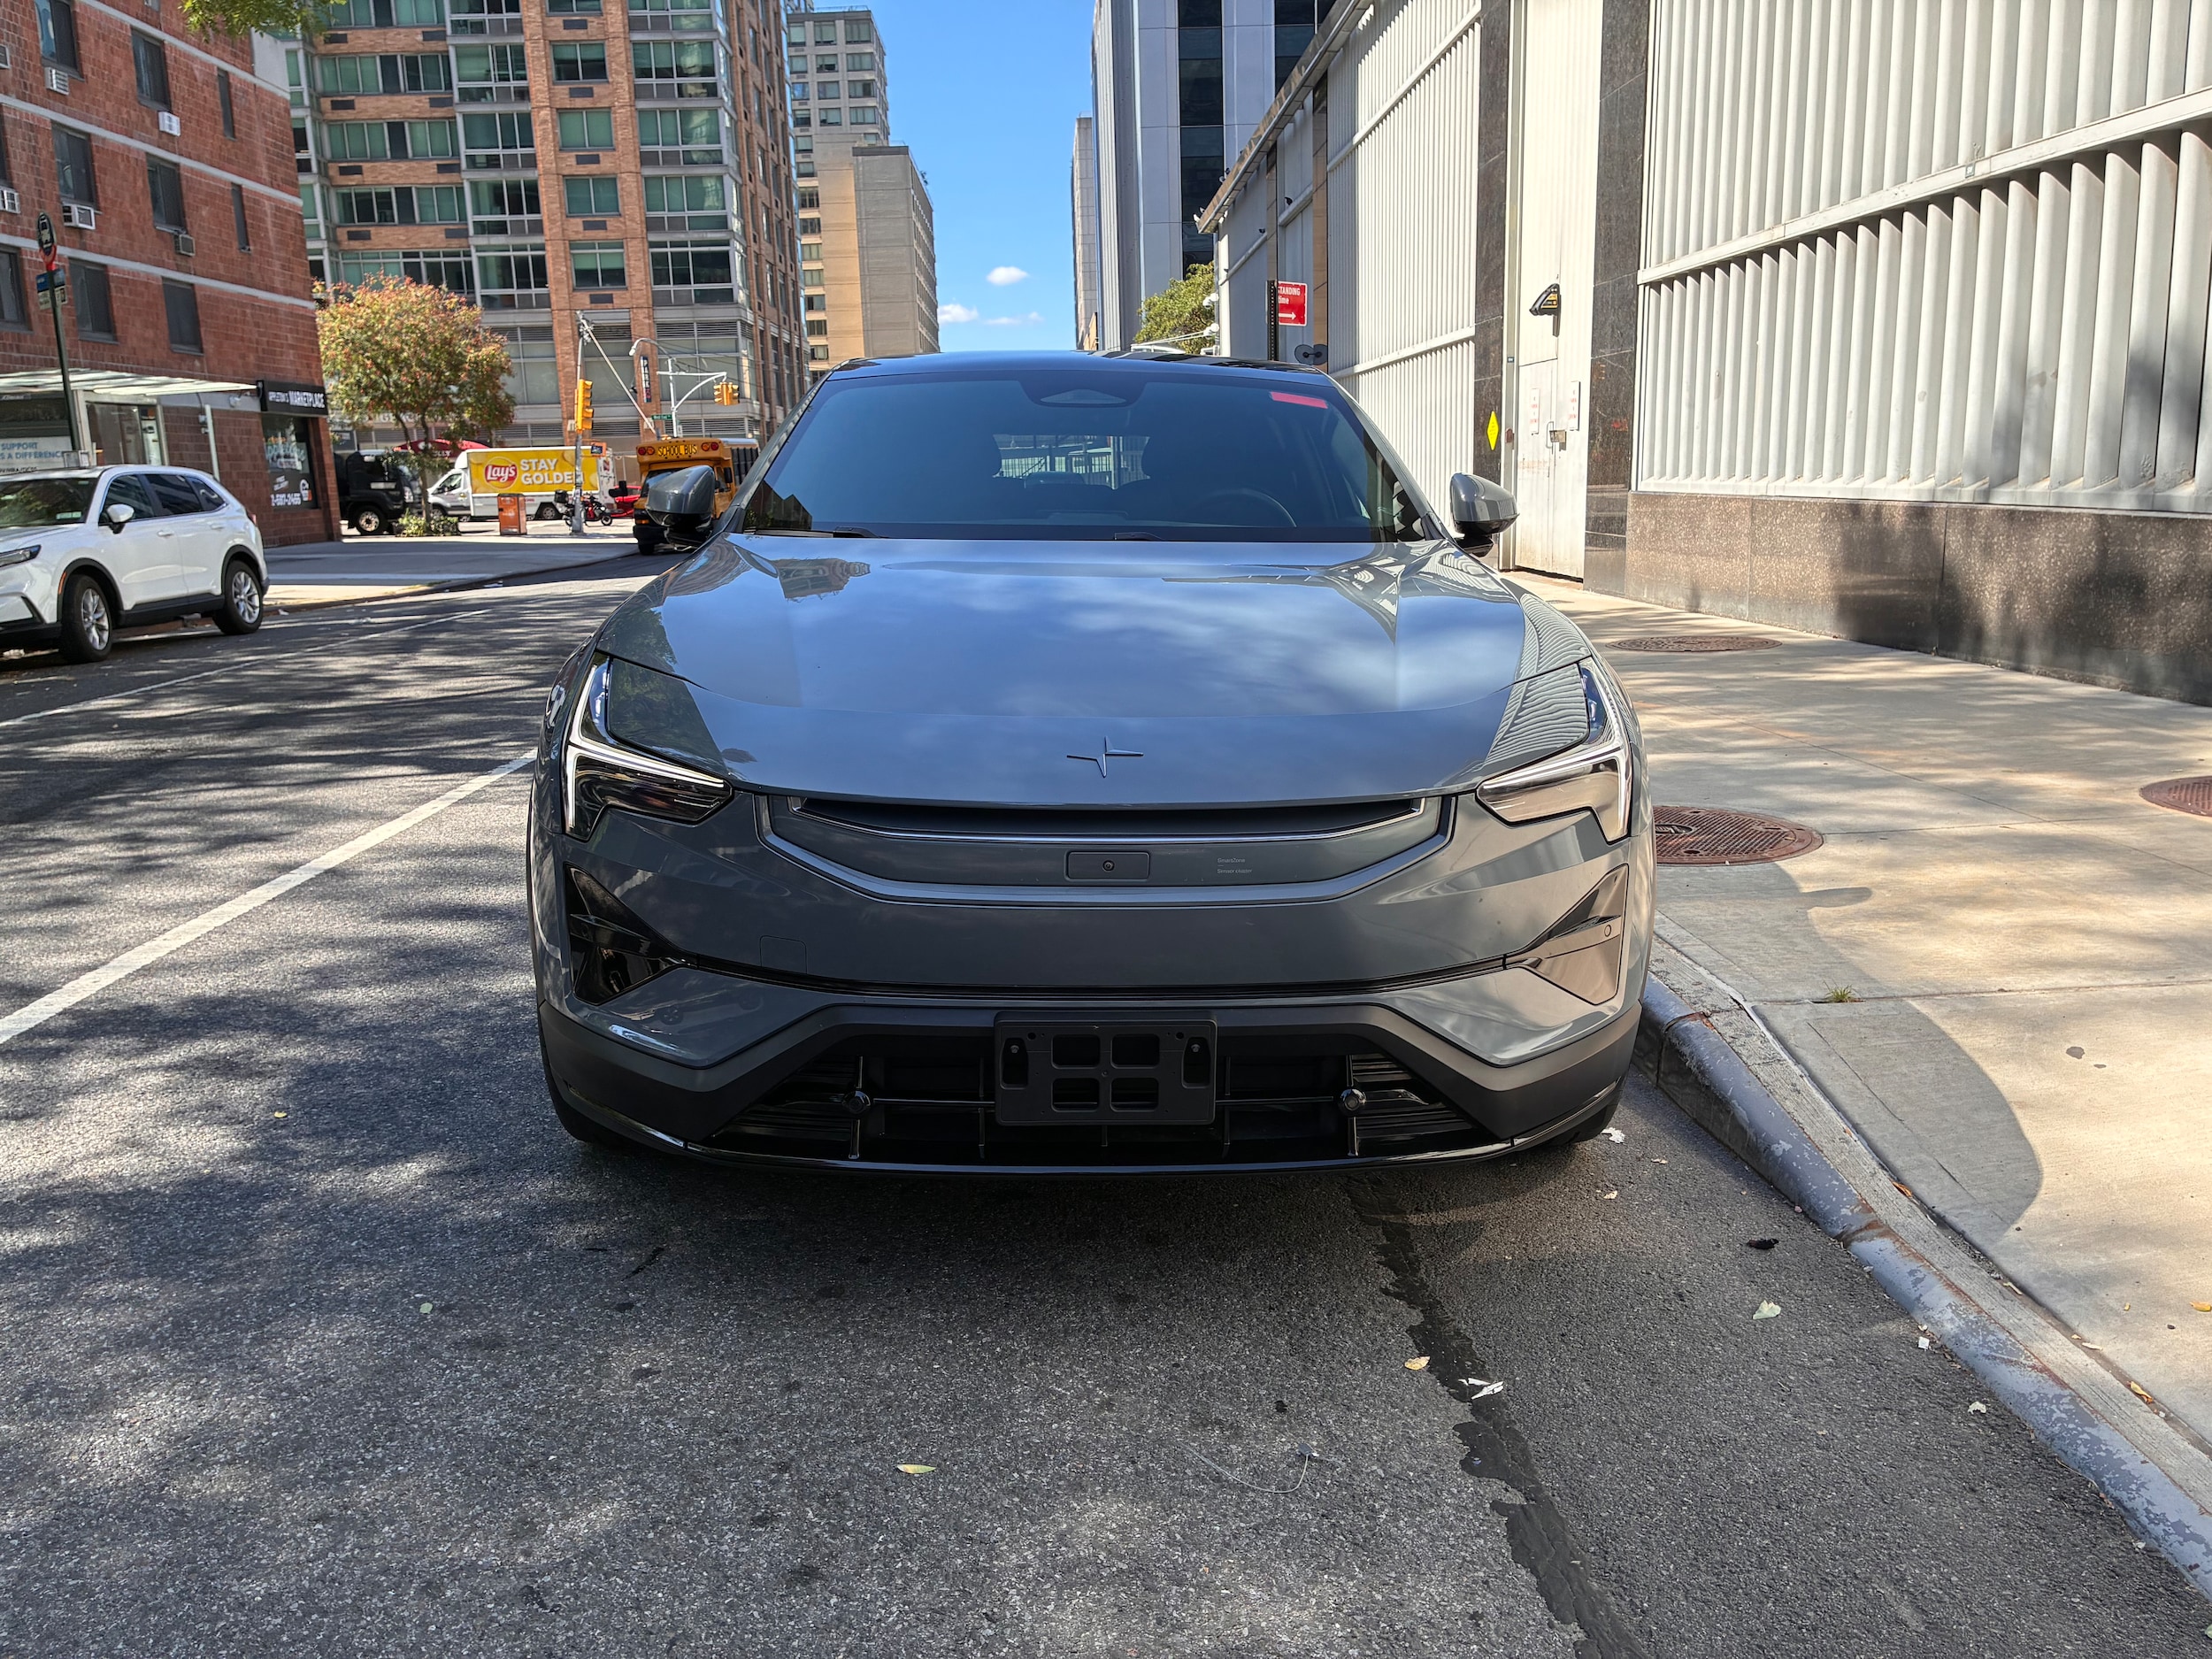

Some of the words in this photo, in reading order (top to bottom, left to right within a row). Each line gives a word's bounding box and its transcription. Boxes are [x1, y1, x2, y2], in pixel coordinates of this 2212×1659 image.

[657, 445, 682, 457] SCHOOL
[685, 444, 698, 455] BUS
[520, 458, 557, 471] STAY
[487, 465, 516, 482] Lay's
